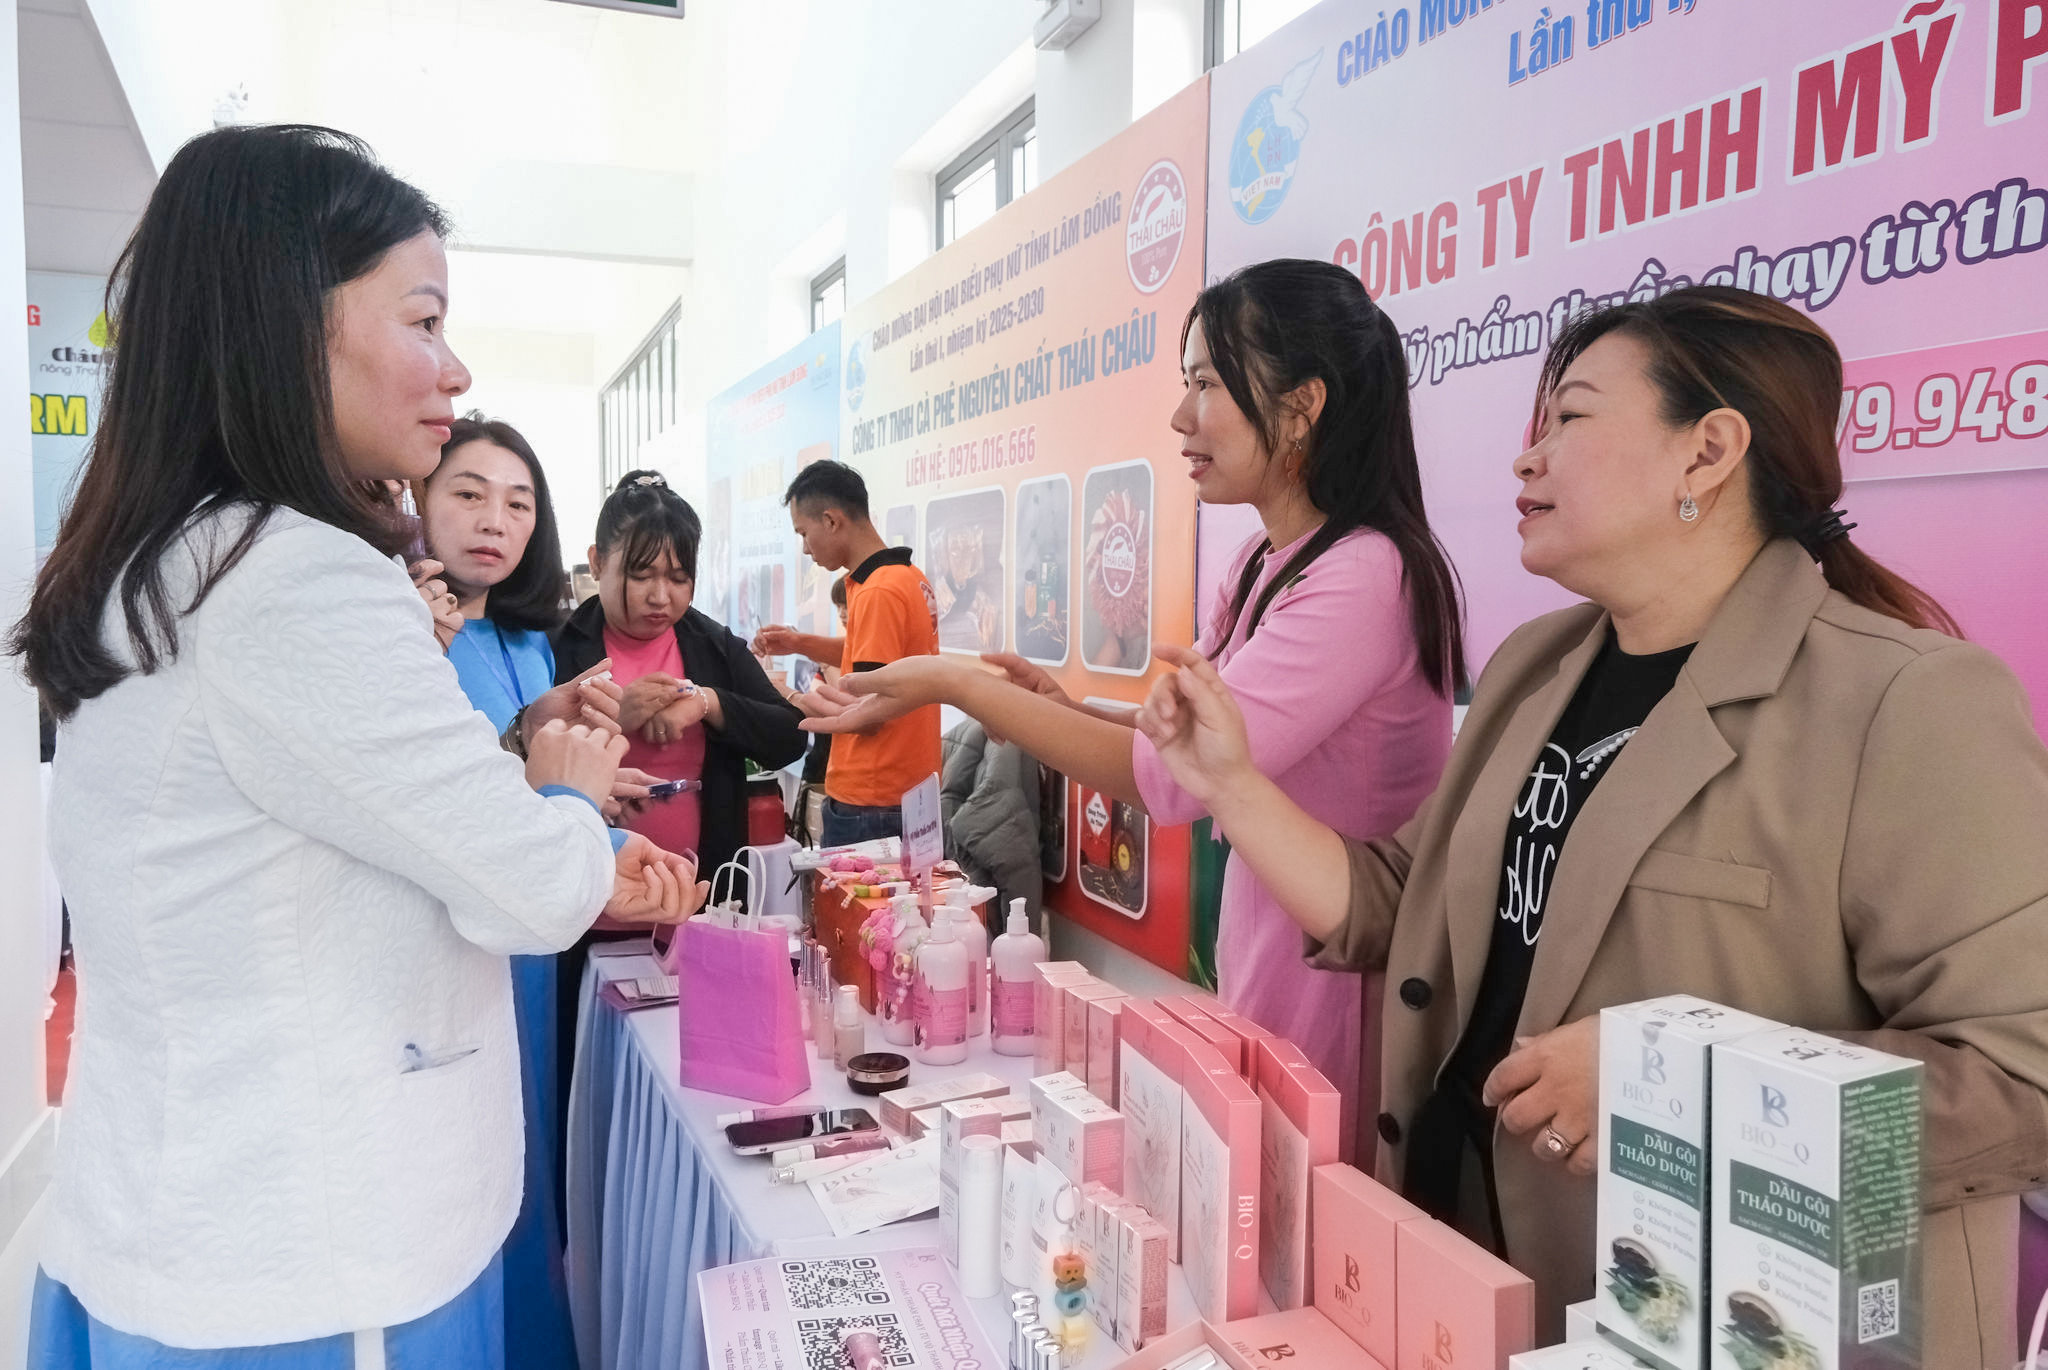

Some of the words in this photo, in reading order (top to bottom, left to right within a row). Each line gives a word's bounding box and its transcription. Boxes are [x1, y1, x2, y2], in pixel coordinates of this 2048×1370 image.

[1336, 11, 1409, 87] CHÀO
[1508, 6, 1575, 87] Lần
[1477, 166, 1544, 269] TY
[1563, 86, 1762, 243] TNHH
[1792, 0, 1957, 176] MỸ
[960, 263, 981, 305] BIỂU
[984, 257, 1003, 292] PHỤ
[1007, 243, 1023, 281] NỮ
[1053, 215, 1080, 256] LÂM
[1084, 190, 1121, 239] ĐỒNG
[990, 286, 1044, 337] 2025-2030
[1401, 326, 1430, 389] ỹ
[1431, 294, 1543, 386] phẩm
[1703, 236, 1856, 312] chay
[1860, 198, 1957, 286] từ
[853, 417, 875, 455] CÔNG
[877, 415, 887, 448] TY
[889, 404, 914, 444] TNHH
[917, 391, 930, 435] CÀ
[934, 381, 955, 430] PHÊ
[958, 363, 1011, 422] NGUYÊN
[1015, 338, 1054, 405] CHẤT
[1058, 327, 1096, 391] THÁI
[1102, 307, 1157, 377] CHÂU
[906, 449, 927, 487] LIÊN
[929, 443, 945, 489] HỆ:
[949, 425, 1036, 479] 0976.016.666
[1622, 1081, 1653, 1105] BIO
[1644, 1132, 1672, 1155] DẦU
[1675, 1145, 1697, 1167] GỘI
[1741, 1122, 1776, 1149] BIO
[1617, 1142, 1656, 1167] THẢO
[1659, 1157, 1697, 1186] DƯỢC
[1238, 1195, 1254, 1228] BIO
[1737, 1189, 1783, 1217] THẢO
[1786, 1207, 1831, 1240] DƯỢC
[1769, 1179, 1800, 1204] DẦU
[1804, 1195, 1831, 1219] GỘI
[1235, 1244, 1253, 1260] Q
[917, 1282, 950, 1308] Quét
[931, 1307, 961, 1328] Mã
[940, 1327, 973, 1359] Nhận
